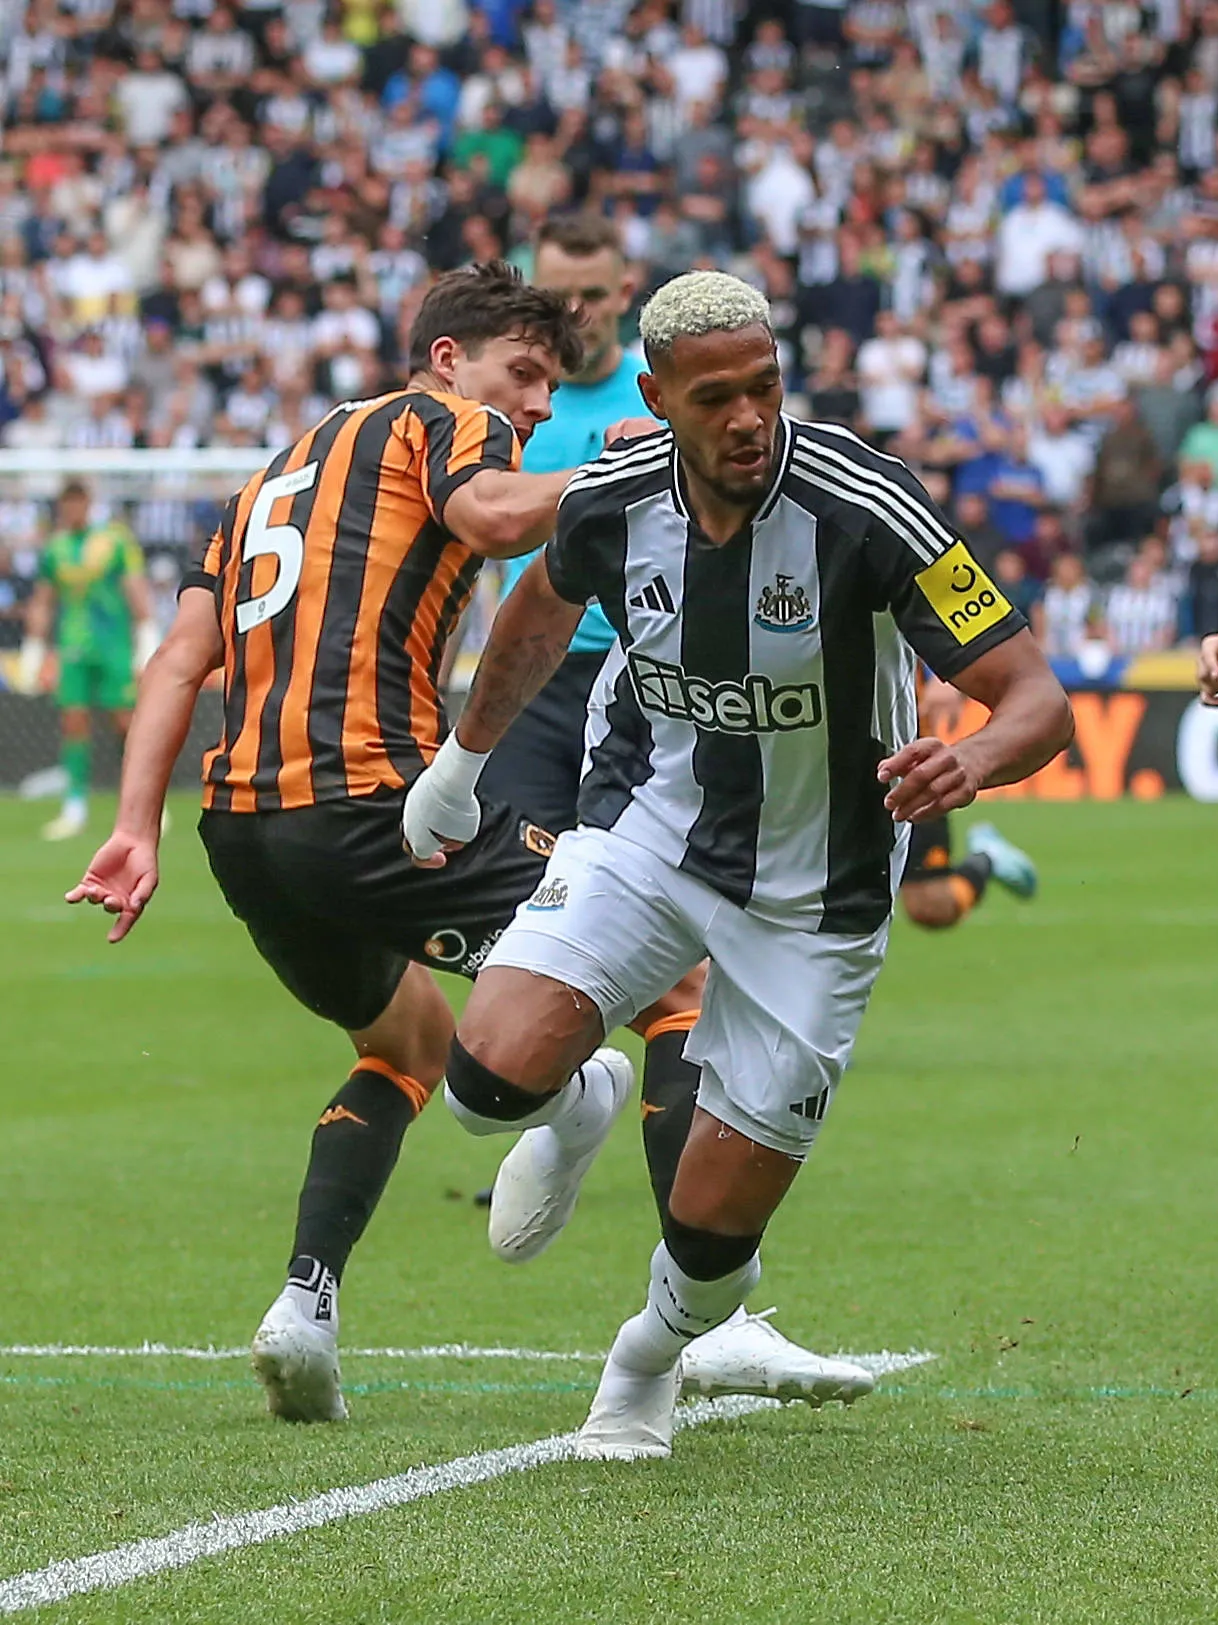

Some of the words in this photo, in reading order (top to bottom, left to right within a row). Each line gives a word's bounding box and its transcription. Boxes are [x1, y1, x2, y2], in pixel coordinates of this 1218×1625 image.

[236, 460, 319, 634] 5
[949, 590, 996, 629] noo
[688, 682, 815, 728] sela
